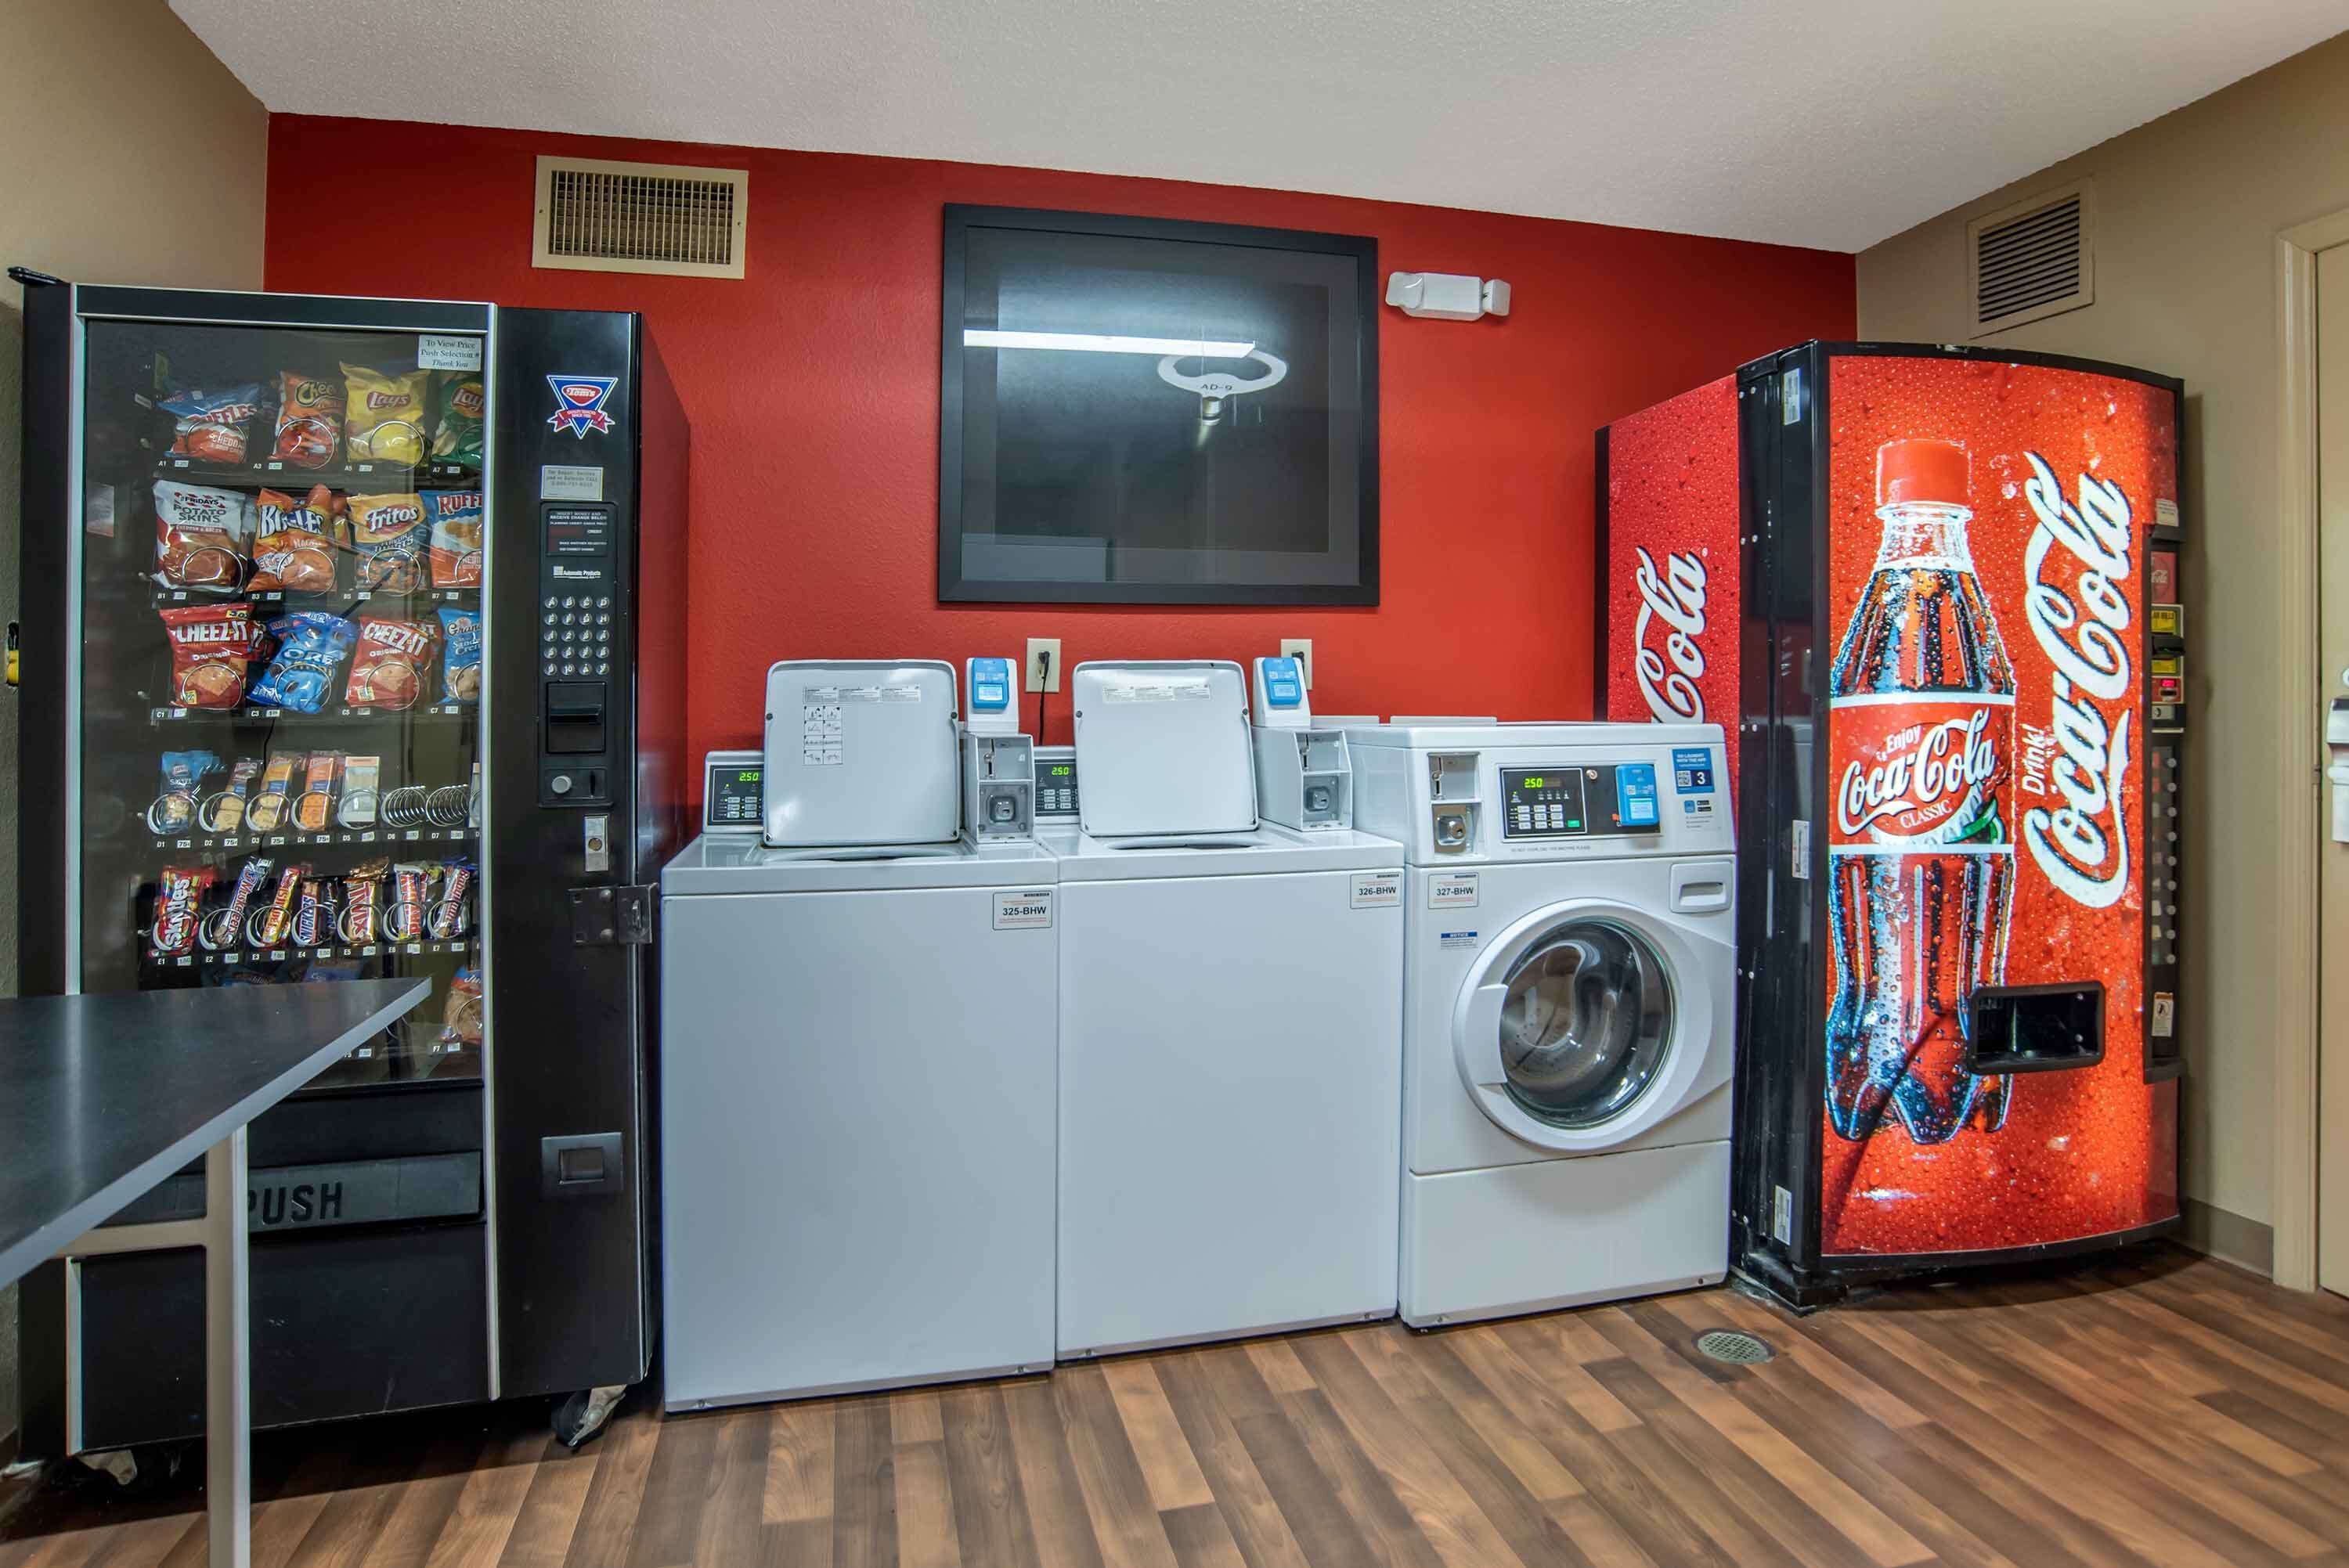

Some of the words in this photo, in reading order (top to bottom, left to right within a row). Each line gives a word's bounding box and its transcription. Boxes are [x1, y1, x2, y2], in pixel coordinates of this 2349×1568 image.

[186, 403, 258, 424] FFLES
[173, 503, 227, 516] POTATO
[438, 495, 482, 516] RUFF
[179, 512, 220, 523] SKINS
[365, 506, 419, 533] Fritos
[176, 619, 249, 643] CHEEZ-IT
[363, 622, 429, 657] CHEEZ-IT
[283, 649, 334, 665] ORE
[2023, 450, 2133, 909] Coca-Cola
[1886, 726, 1922, 753] Enjoy
[2020, 723, 2047, 795] Drink!
[1697, 772, 1705, 784] 3
[1838, 707, 1996, 836] Coca-Cola
[1900, 798, 1953, 828] CLASSIC
[1359, 886, 1397, 896] 326-BHW
[1436, 887, 1474, 896] 327-BHW
[300, 896, 316, 942] SNICKERS
[1002, 907, 1046, 916] 325-BHW
